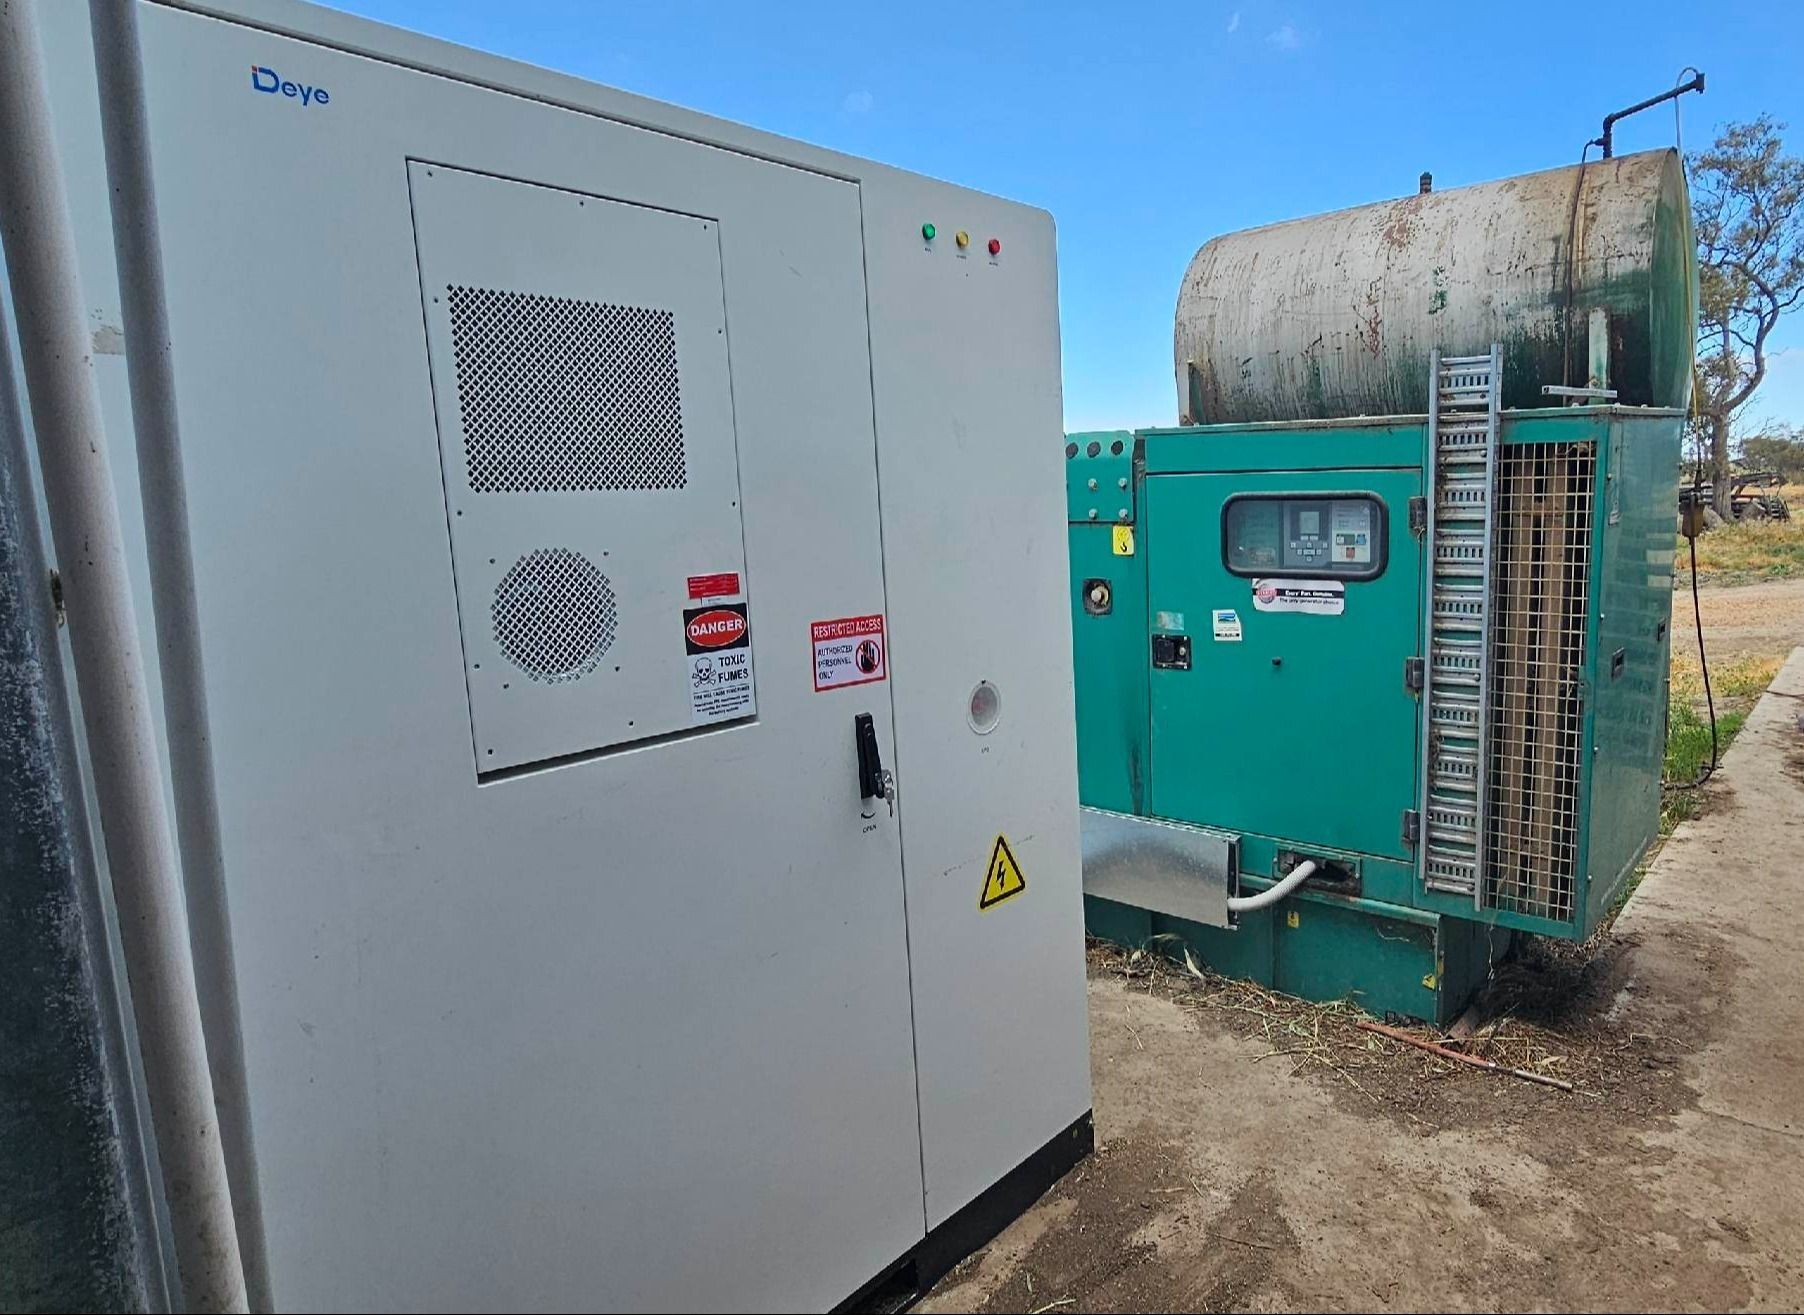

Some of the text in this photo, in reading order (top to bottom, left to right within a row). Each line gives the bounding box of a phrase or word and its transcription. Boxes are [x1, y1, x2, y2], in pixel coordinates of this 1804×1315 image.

[251, 65, 330, 106] Deye
[690, 618, 743, 637] DANGER
[813, 617, 882, 638] RESTRICTED ACCESS
[817, 645, 853, 657] AUTHORIZED
[718, 653, 746, 667] TOXIC
[818, 657, 852, 669] PERSONNEL
[718, 668, 749, 684] FUMES
[818, 670, 834, 680] ONLY
[862, 824, 877, 833] OPEN
